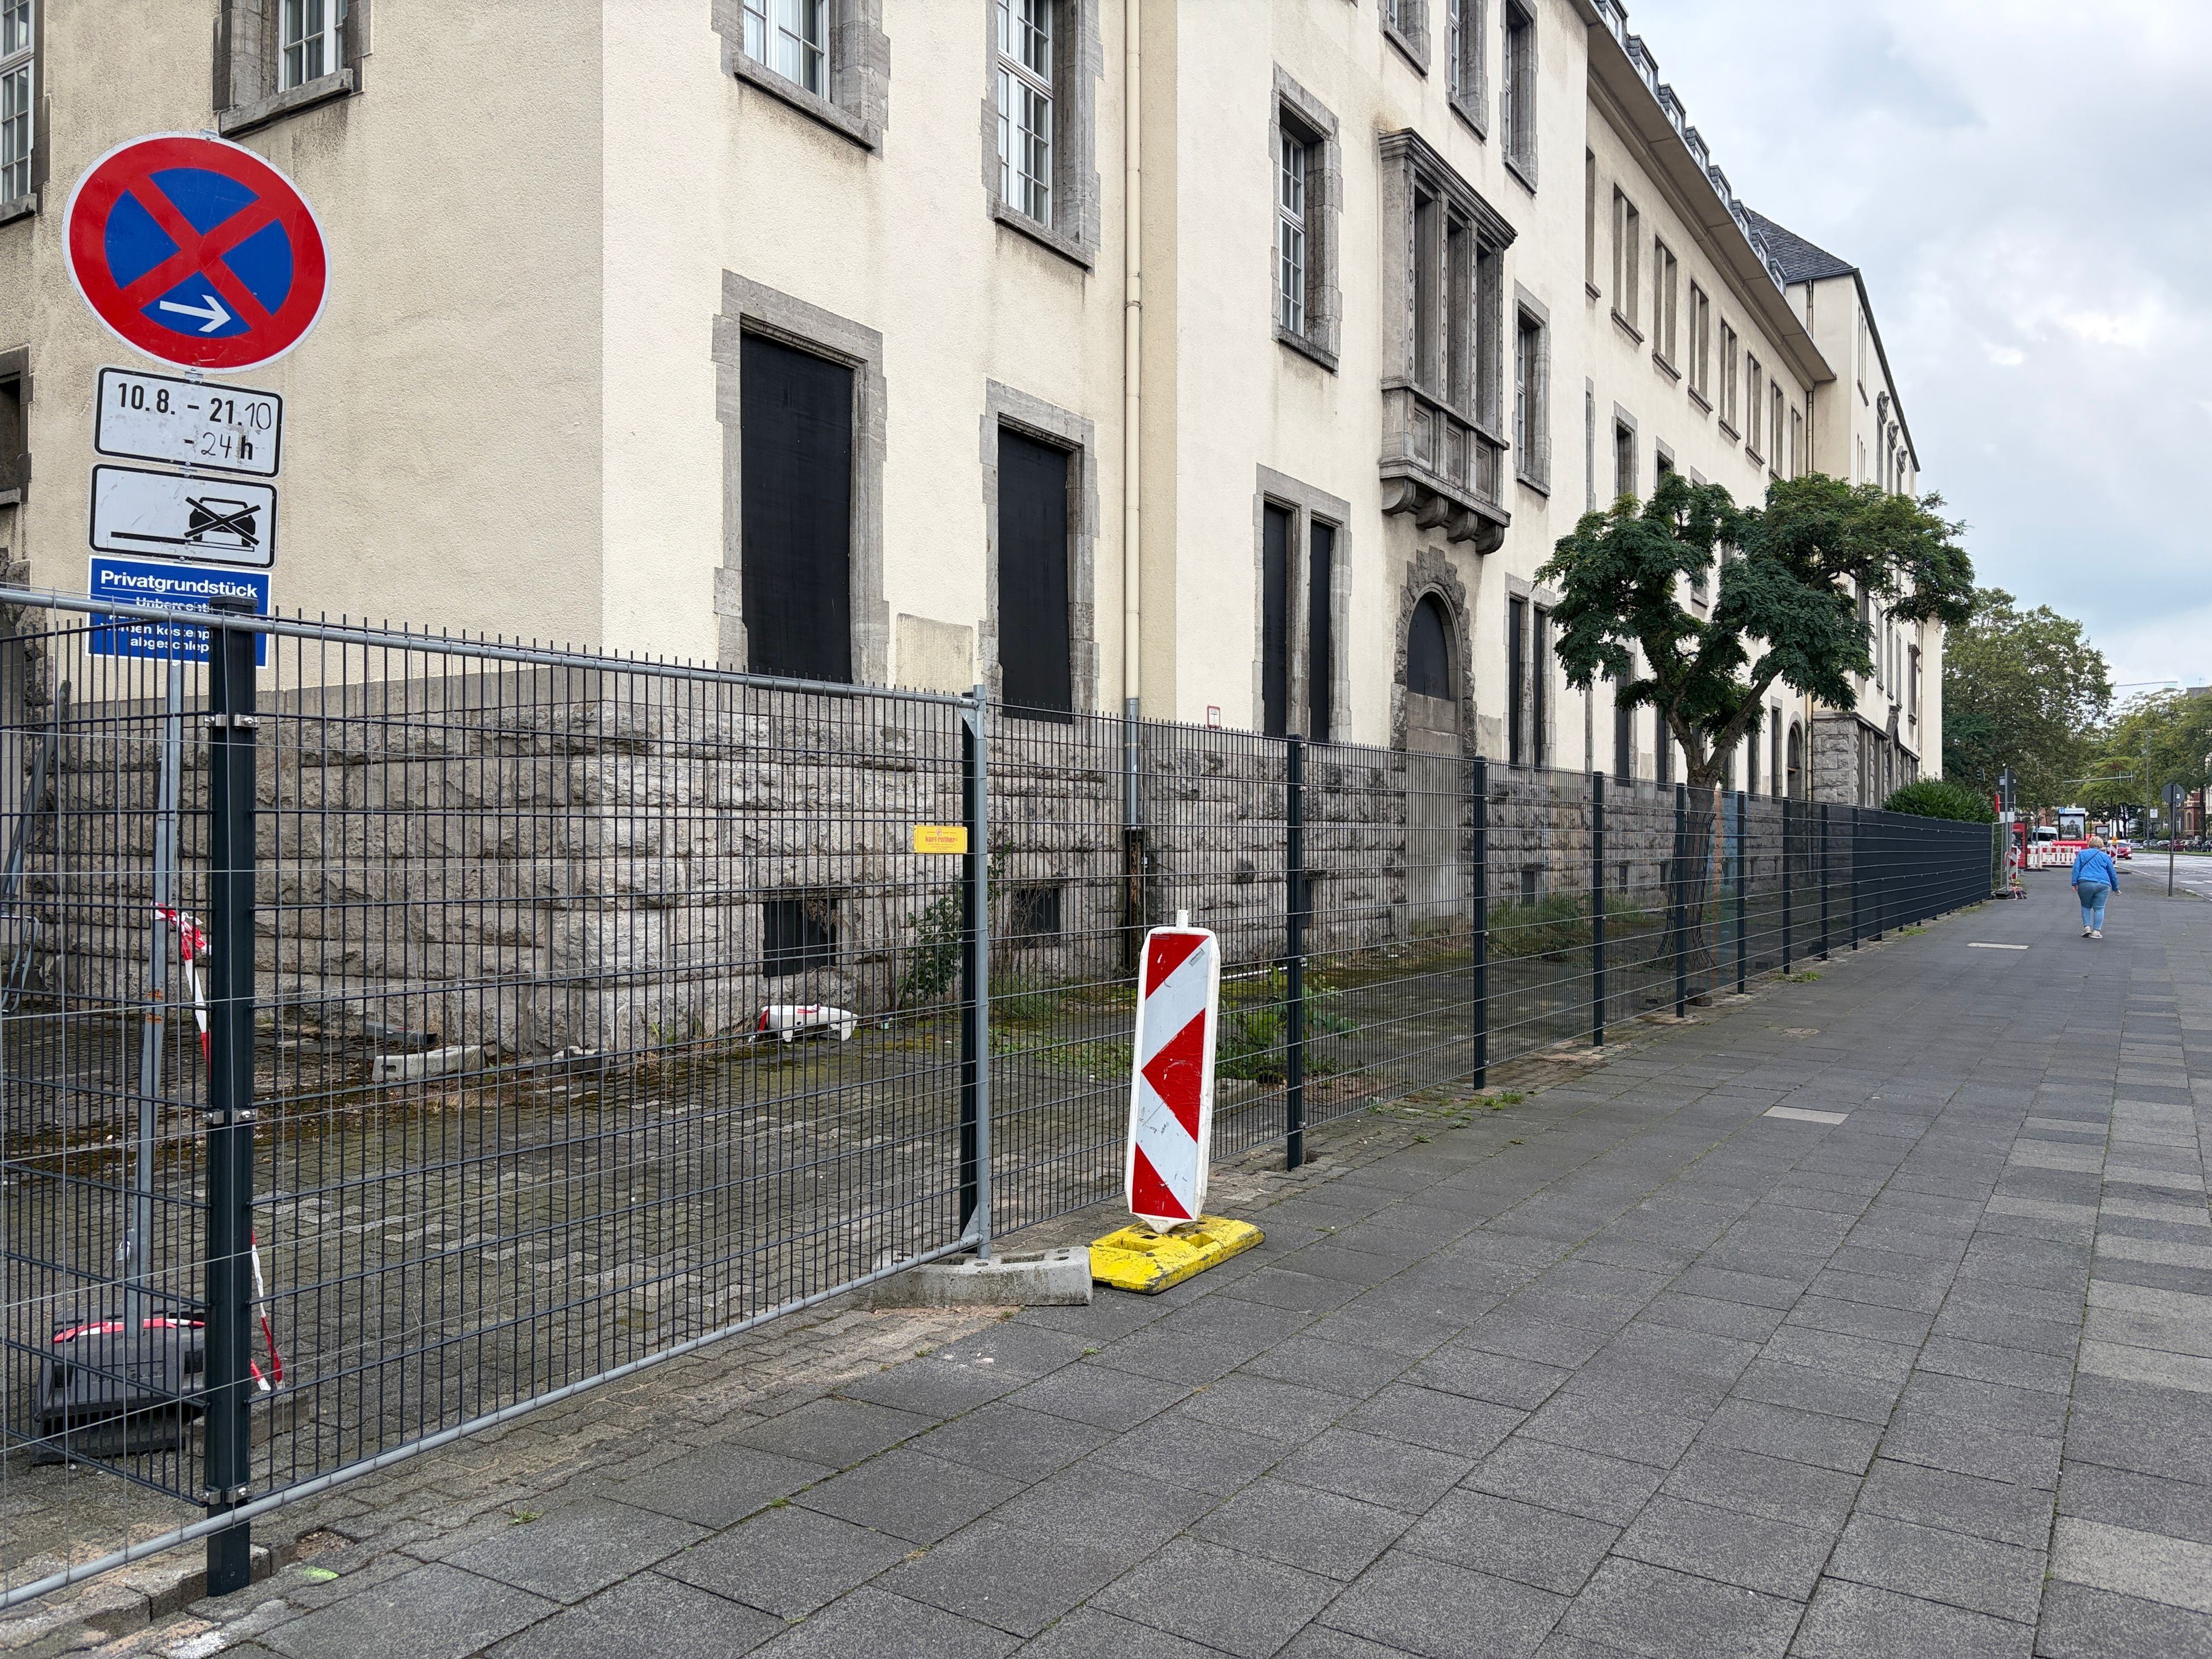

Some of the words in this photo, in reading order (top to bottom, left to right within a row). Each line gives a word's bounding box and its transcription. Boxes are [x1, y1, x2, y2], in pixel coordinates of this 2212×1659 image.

[118, 383, 175, 415] 10.8.
[209, 398, 272, 430] 21.10
[101, 570, 258, 598] Privatgrundstück
